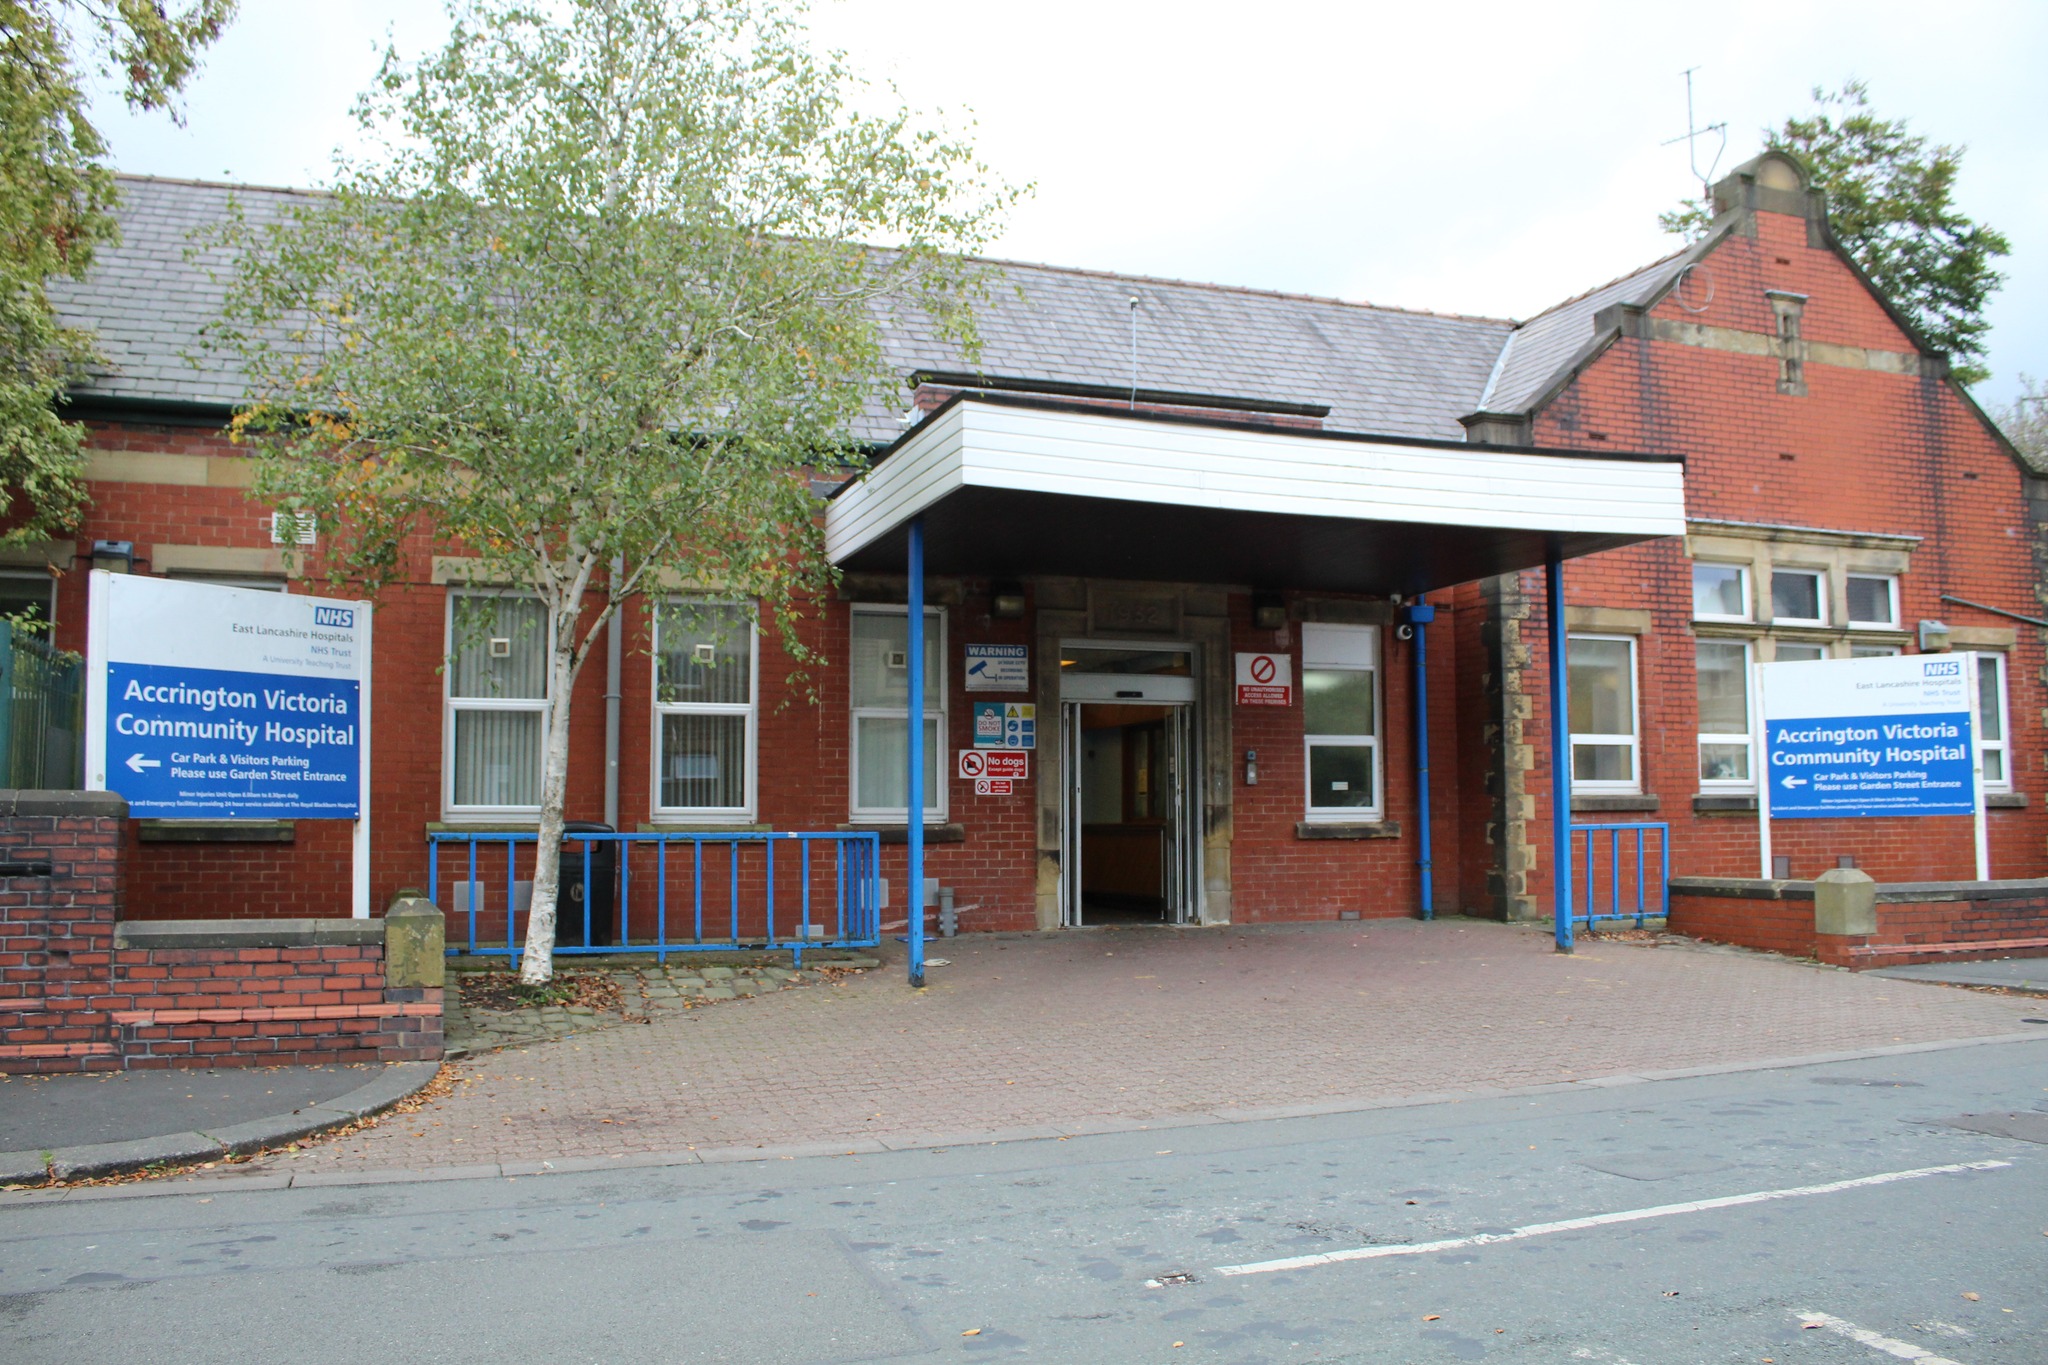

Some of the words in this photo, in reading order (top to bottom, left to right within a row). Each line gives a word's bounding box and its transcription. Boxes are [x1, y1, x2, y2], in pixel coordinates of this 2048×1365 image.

[316, 608, 352, 626] NHS
[232, 624, 254, 634] East
[257, 625, 308, 639] Lancashire
[311, 631, 354, 643] Hospitals
[311, 646, 328, 655] NHS
[331, 648, 351, 657] Trust
[968, 647, 1024, 656] WARNING
[270, 656, 303, 667] University
[305, 659, 334, 670] Teaching
[334, 661, 351, 670] Trust
[1925, 663, 1958, 675] NHS
[1922, 678, 1962, 686] Hospitals
[124, 680, 256, 710] Accrington
[264, 689, 347, 714] Victoria
[116, 714, 259, 745] Community
[265, 722, 354, 748] Hospital
[1776, 728, 1878, 745] Accrington
[1883, 722, 1958, 739] Victoria
[171, 753, 190, 763] Car
[193, 754, 216, 763] Park
[220, 755, 228, 764] &
[230, 755, 269, 765] Visitors
[272, 756, 309, 769] Parking
[1002, 757, 1024, 767] dogs
[1772, 748, 1881, 766] Community
[1886, 745, 1965, 764] Hospital
[171, 768, 206, 778] Please
[209, 771, 227, 779] use
[230, 769, 268, 780] Garden
[271, 770, 301, 780] Street
[303, 771, 346, 782] Entrance
[1894, 771, 1927, 780] Parking
[1814, 783, 1840, 791] Please
